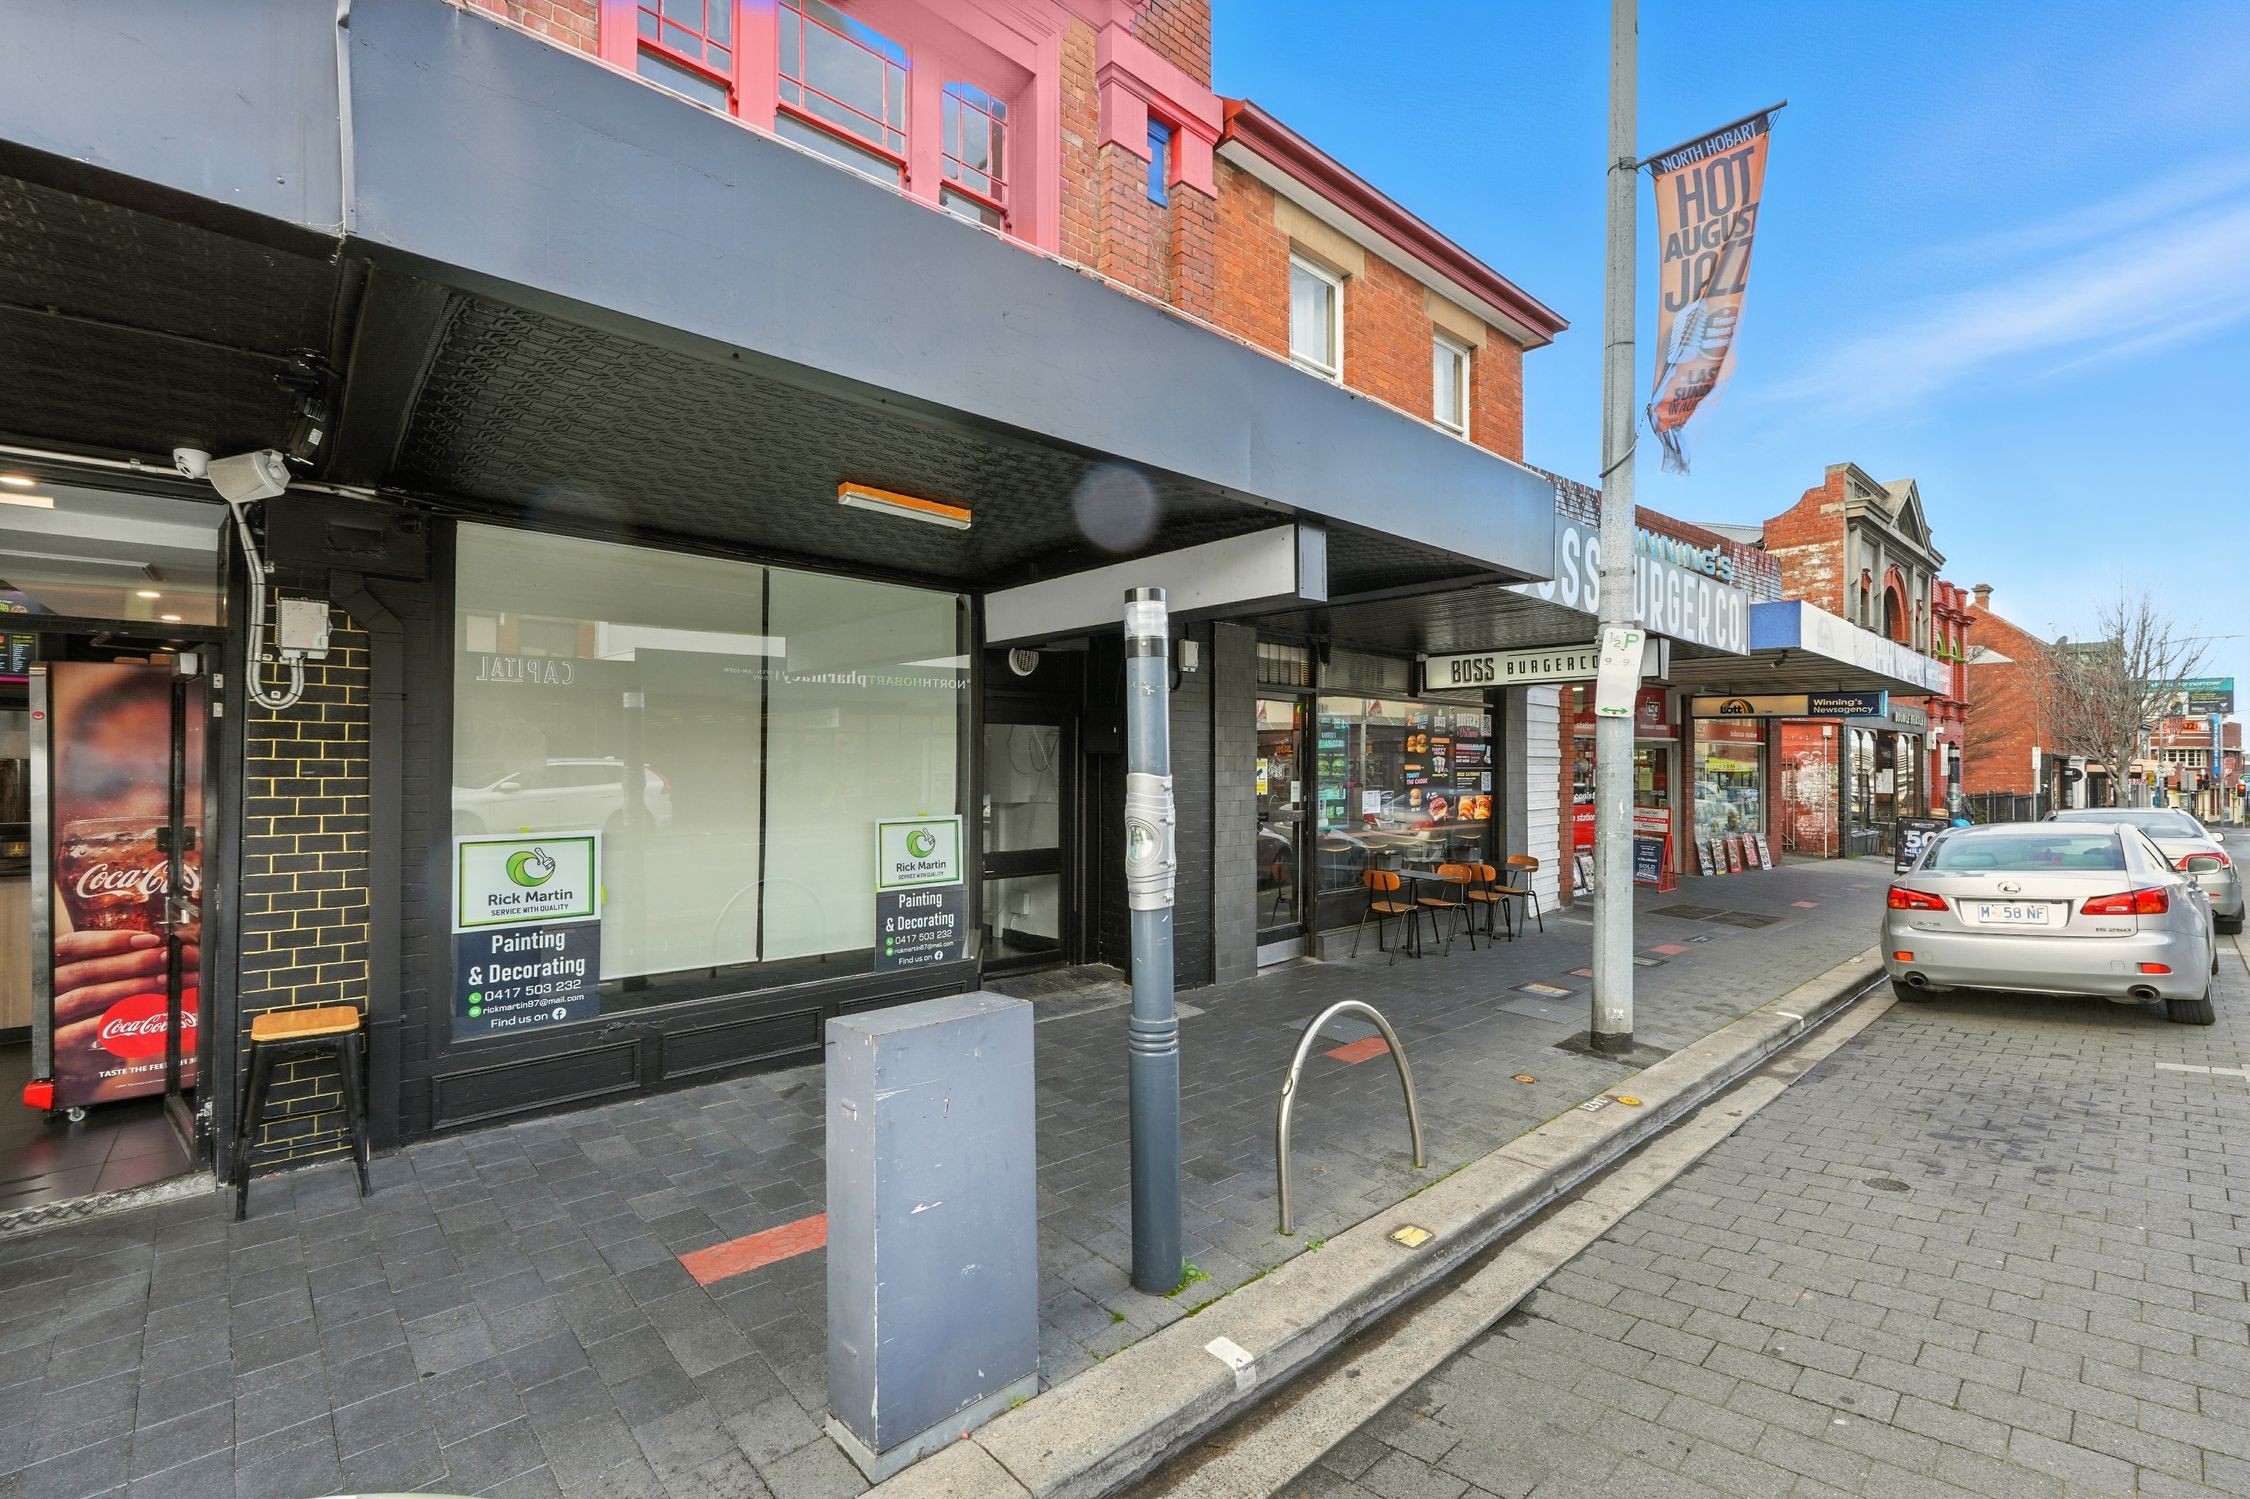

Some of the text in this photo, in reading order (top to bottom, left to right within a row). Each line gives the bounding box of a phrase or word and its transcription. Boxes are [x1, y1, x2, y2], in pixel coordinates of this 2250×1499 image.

[1661, 121, 1758, 174] NORTH HOBART
[1675, 146, 1755, 230] HOT
[1664, 202, 1759, 264] AUGUST
[1688, 367, 1719, 385] LAS
[1634, 527, 1732, 581] INNING'S
[1634, 554, 1710, 645] URGER
[1624, 633, 1640, 648] P
[1452, 657, 1495, 683] BOSS
[1813, 698, 1863, 707] Winning's
[1813, 705, 1874, 715] Newsagency
[896, 860, 946, 872] Rick Martin
[488, 889, 573, 906] Rick Martin
[899, 891, 943, 908] Painting
[491, 903, 569, 916] SERVICE WITH QUALITY
[1981, 906, 2045, 919] M 58 NF
[886, 912, 955, 932] & Decorating
[491, 931, 566, 954] Painting
[895, 930, 952, 945] 0417 503 232
[898, 956, 914, 965] Find
[468, 957, 586, 986] & Decorating
[484, 979, 582, 1002] 0417 503 232
[482, 993, 585, 1015] rickmartin87@mail.com
[490, 1013, 548, 1029] Find us on
[99, 1068, 128, 1078] TASTE
[129, 1065, 147, 1073] THE
